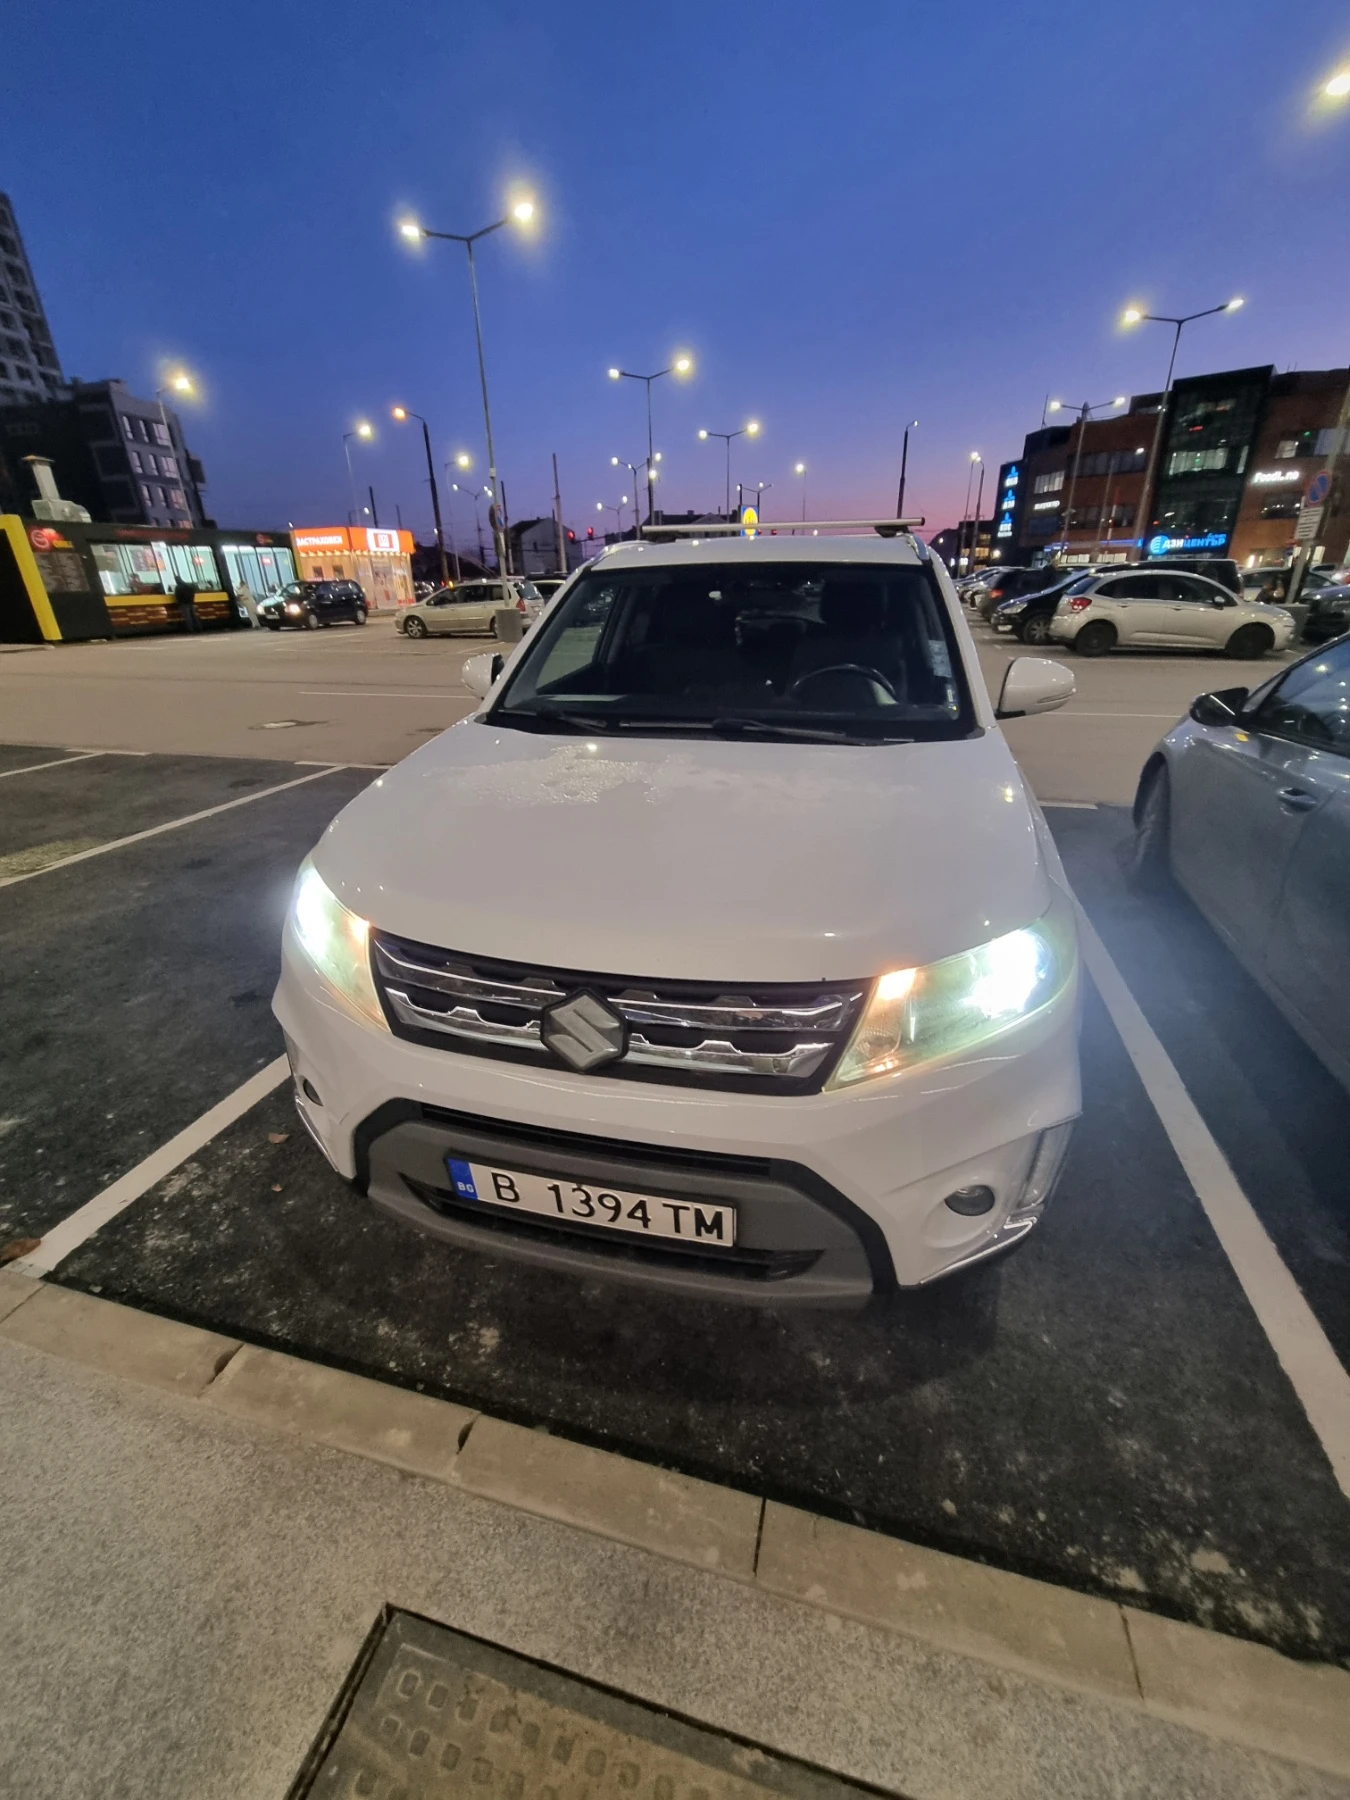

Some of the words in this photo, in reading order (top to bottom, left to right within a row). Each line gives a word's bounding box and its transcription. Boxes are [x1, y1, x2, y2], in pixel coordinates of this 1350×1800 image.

[457, 1182, 474, 1193] BG
[491, 1171, 520, 1203] B
[547, 1183, 652, 1229] 1394
[662, 1202, 724, 1240] TM
